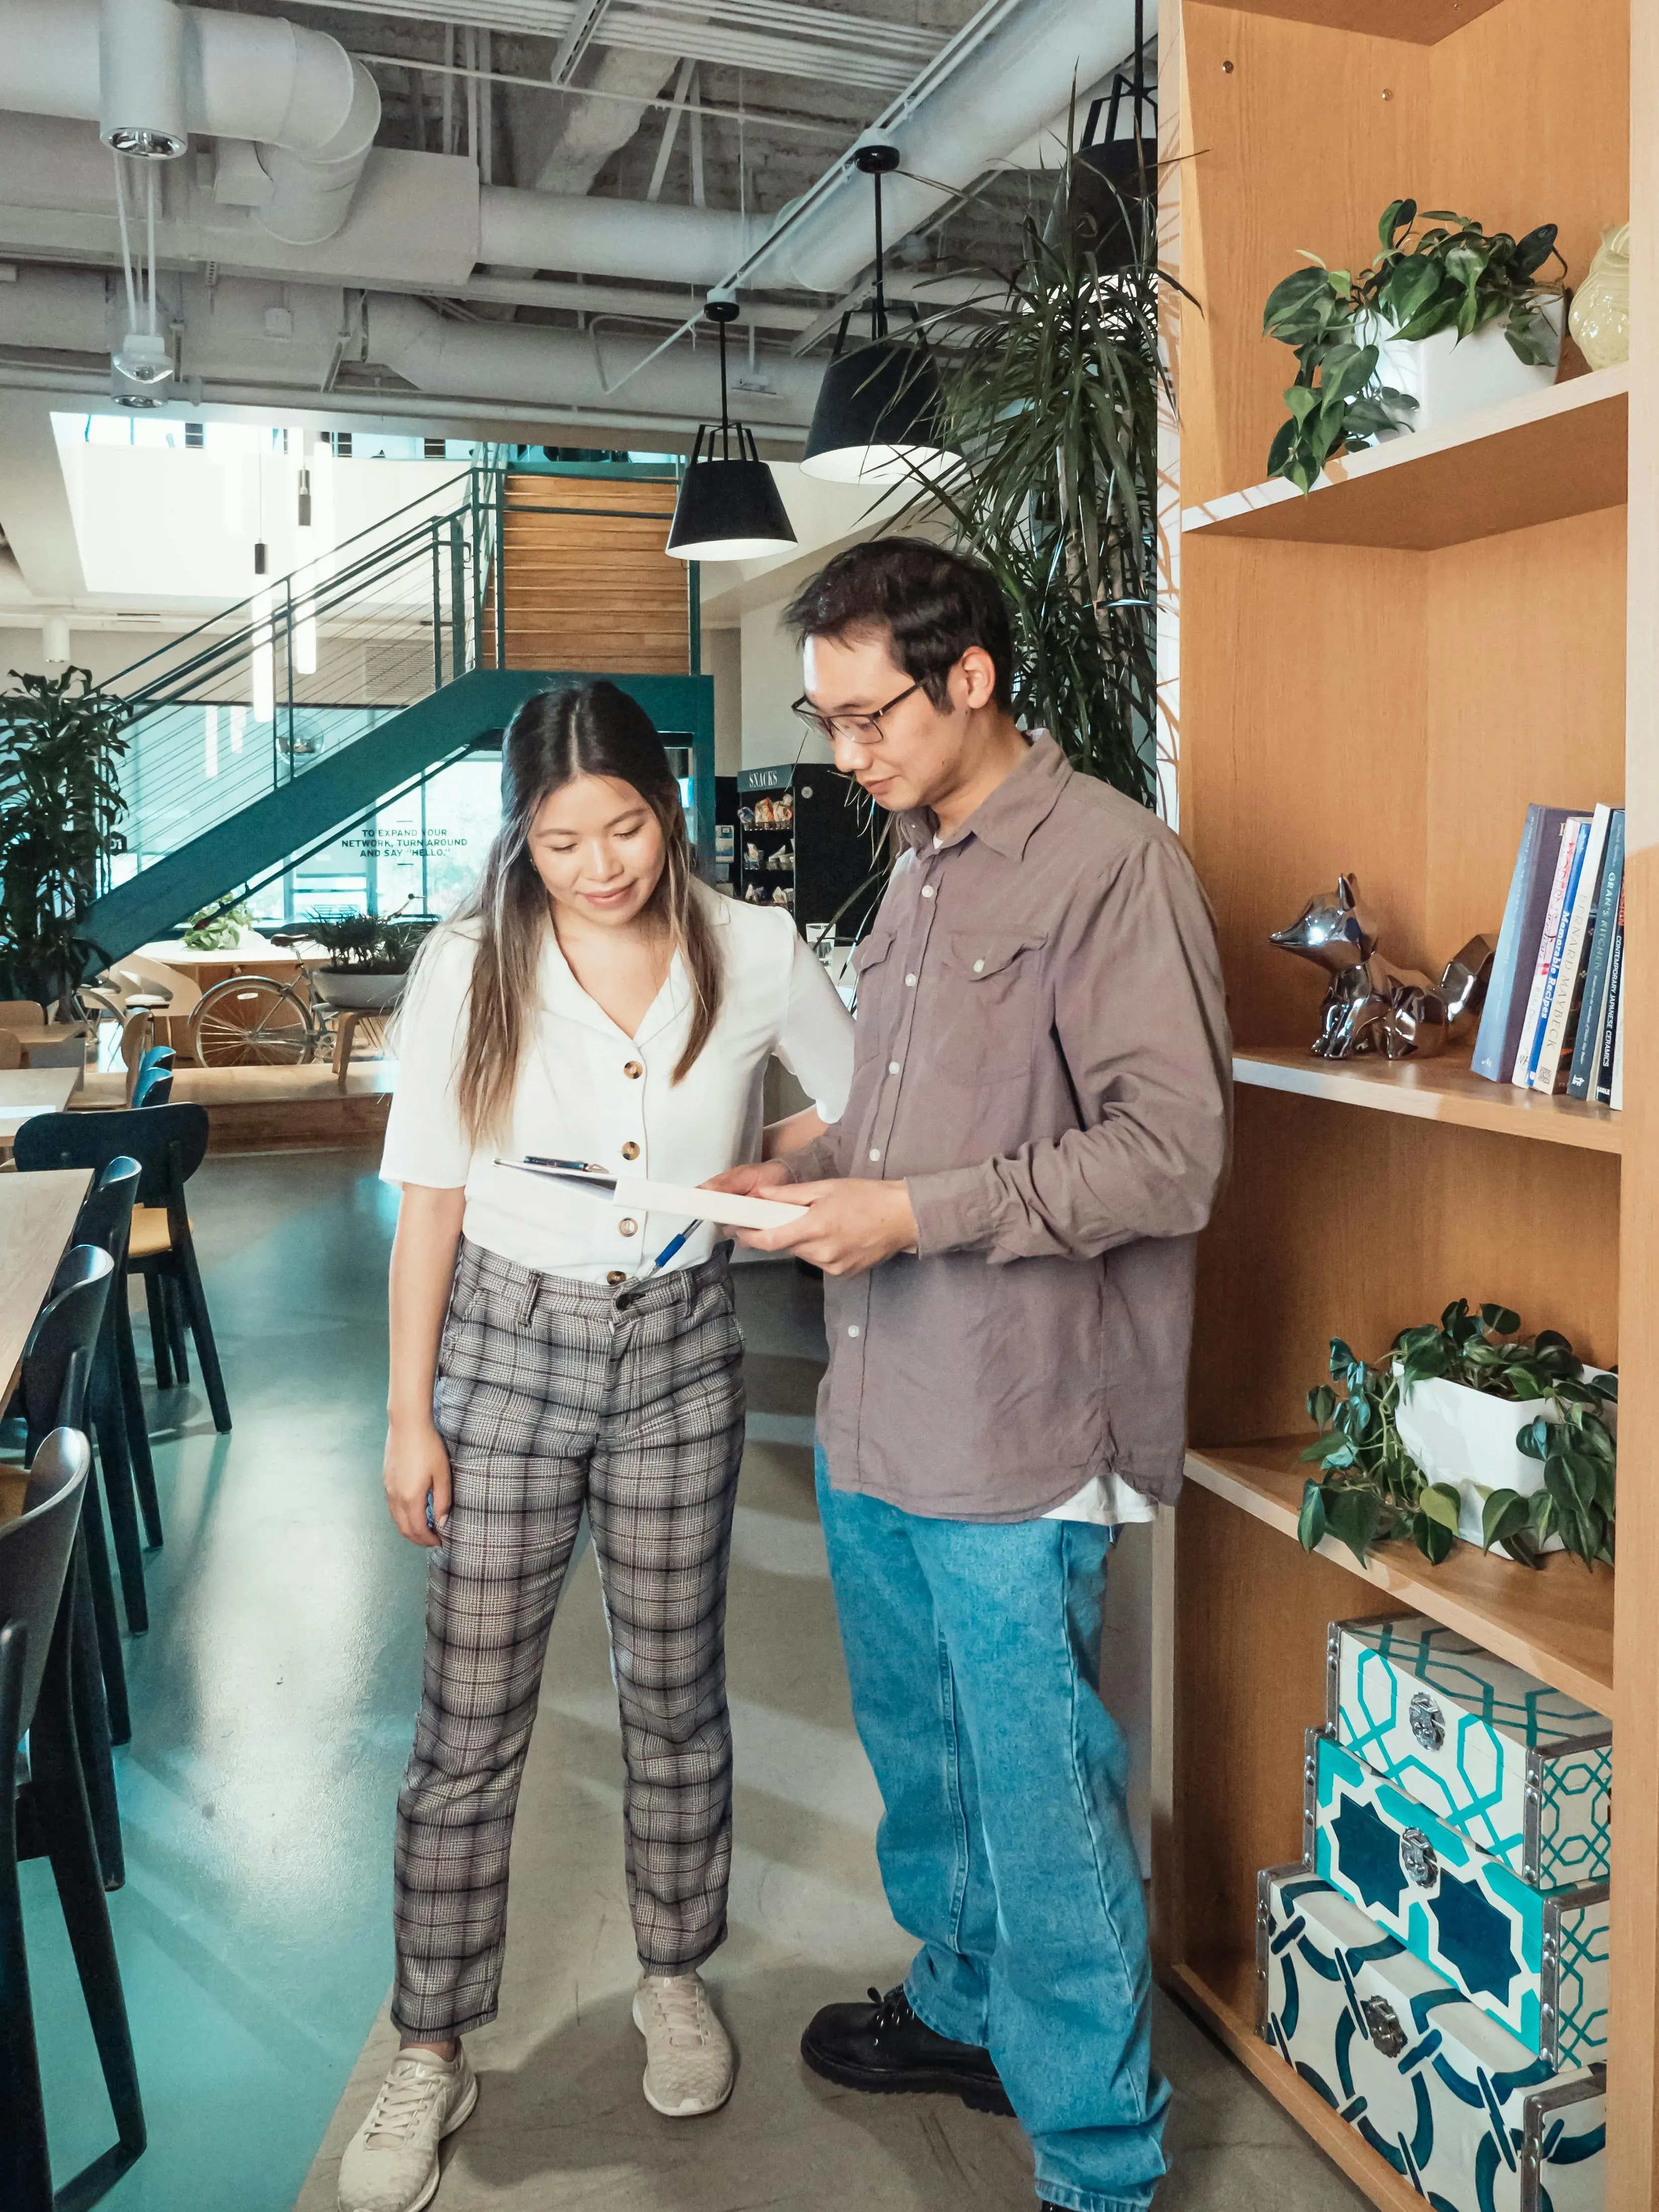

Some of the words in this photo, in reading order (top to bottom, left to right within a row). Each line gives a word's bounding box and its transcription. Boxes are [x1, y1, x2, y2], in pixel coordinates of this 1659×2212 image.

[749, 770, 777, 788] SNACKS
[342, 839, 393, 848] NETWORK,
[427, 838, 467, 847] AROUND
[360, 849, 380, 858] AND
[422, 829, 447, 837] YOUR
[1602, 872, 1616, 916] GRAN'S
[1550, 911, 1570, 974] Memorable
[1564, 894, 1588, 970] BERNARD
[1595, 920, 1608, 971] KITCHEN
[1611, 935, 1622, 993] CONTEMPORARY
[1541, 978, 1556, 1019] Recipes
[1546, 975, 1570, 1050] MAYBECK
[1607, 994, 1615, 1029] JAPANESE
[1603, 1030, 1612, 1067] CERAMICS
